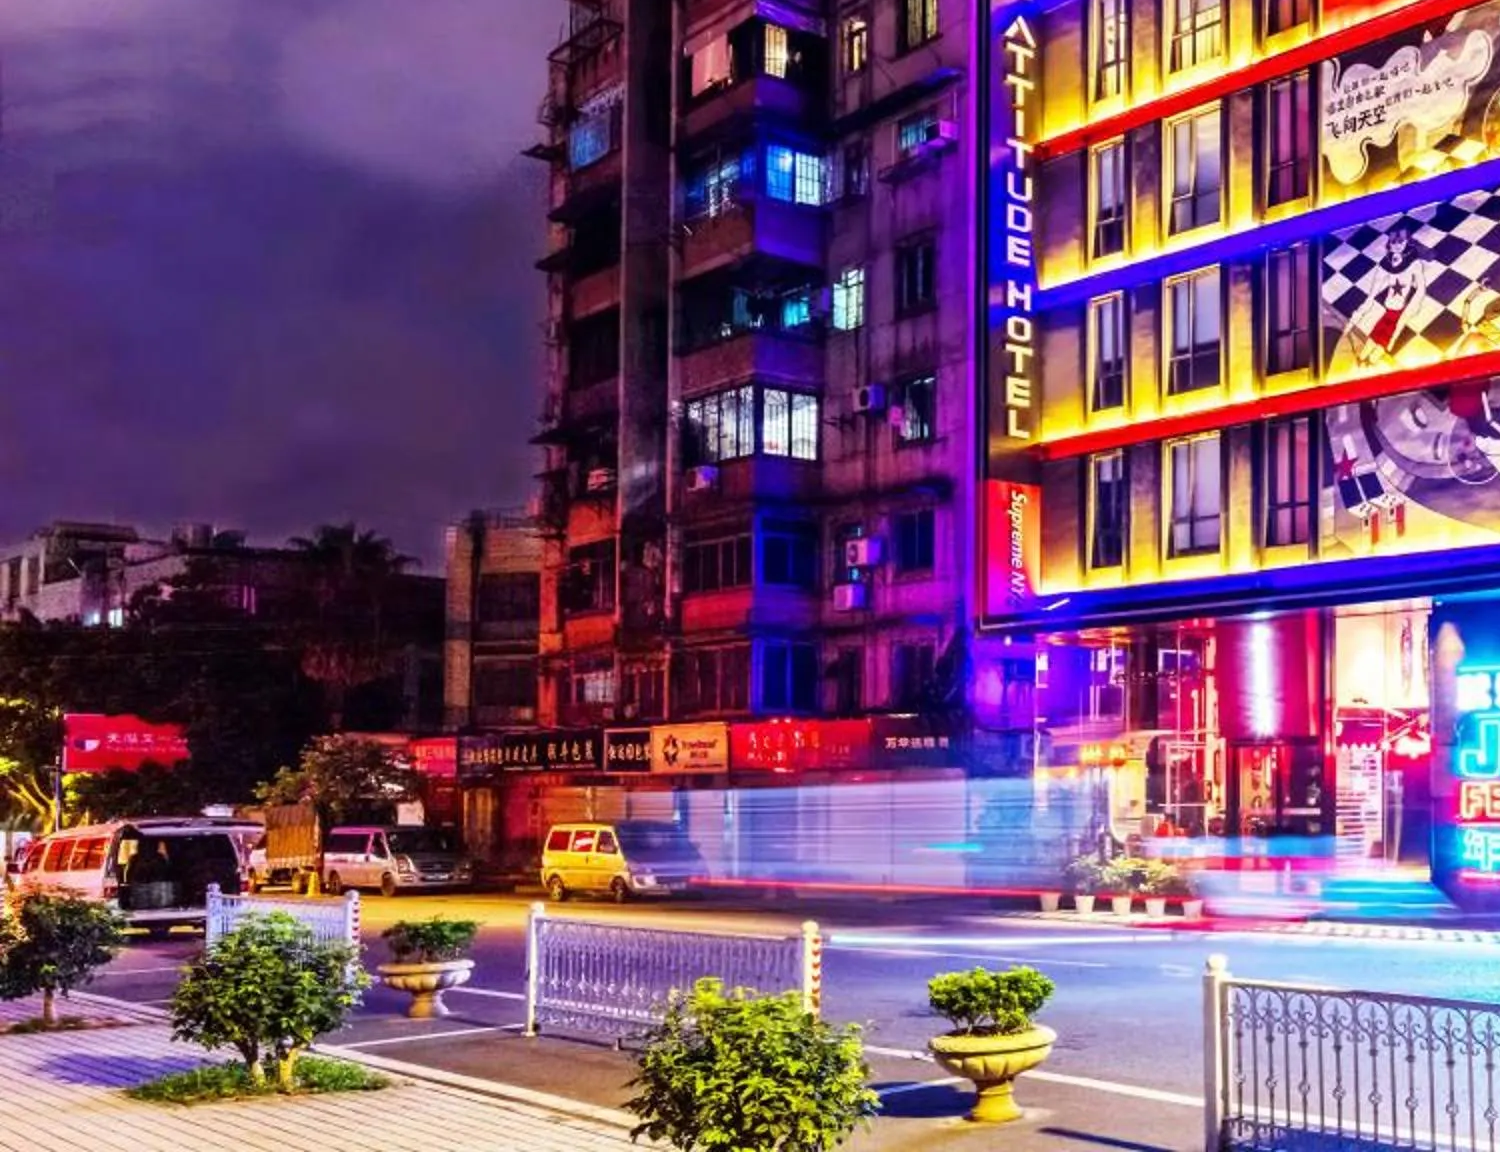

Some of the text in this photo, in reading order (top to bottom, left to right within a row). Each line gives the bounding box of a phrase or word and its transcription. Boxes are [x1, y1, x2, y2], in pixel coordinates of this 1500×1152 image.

[1004, 15, 1036, 267] ATTITUDE
[1005, 280, 1034, 440] HOTEL
[1007, 490, 1028, 569] Supreme
